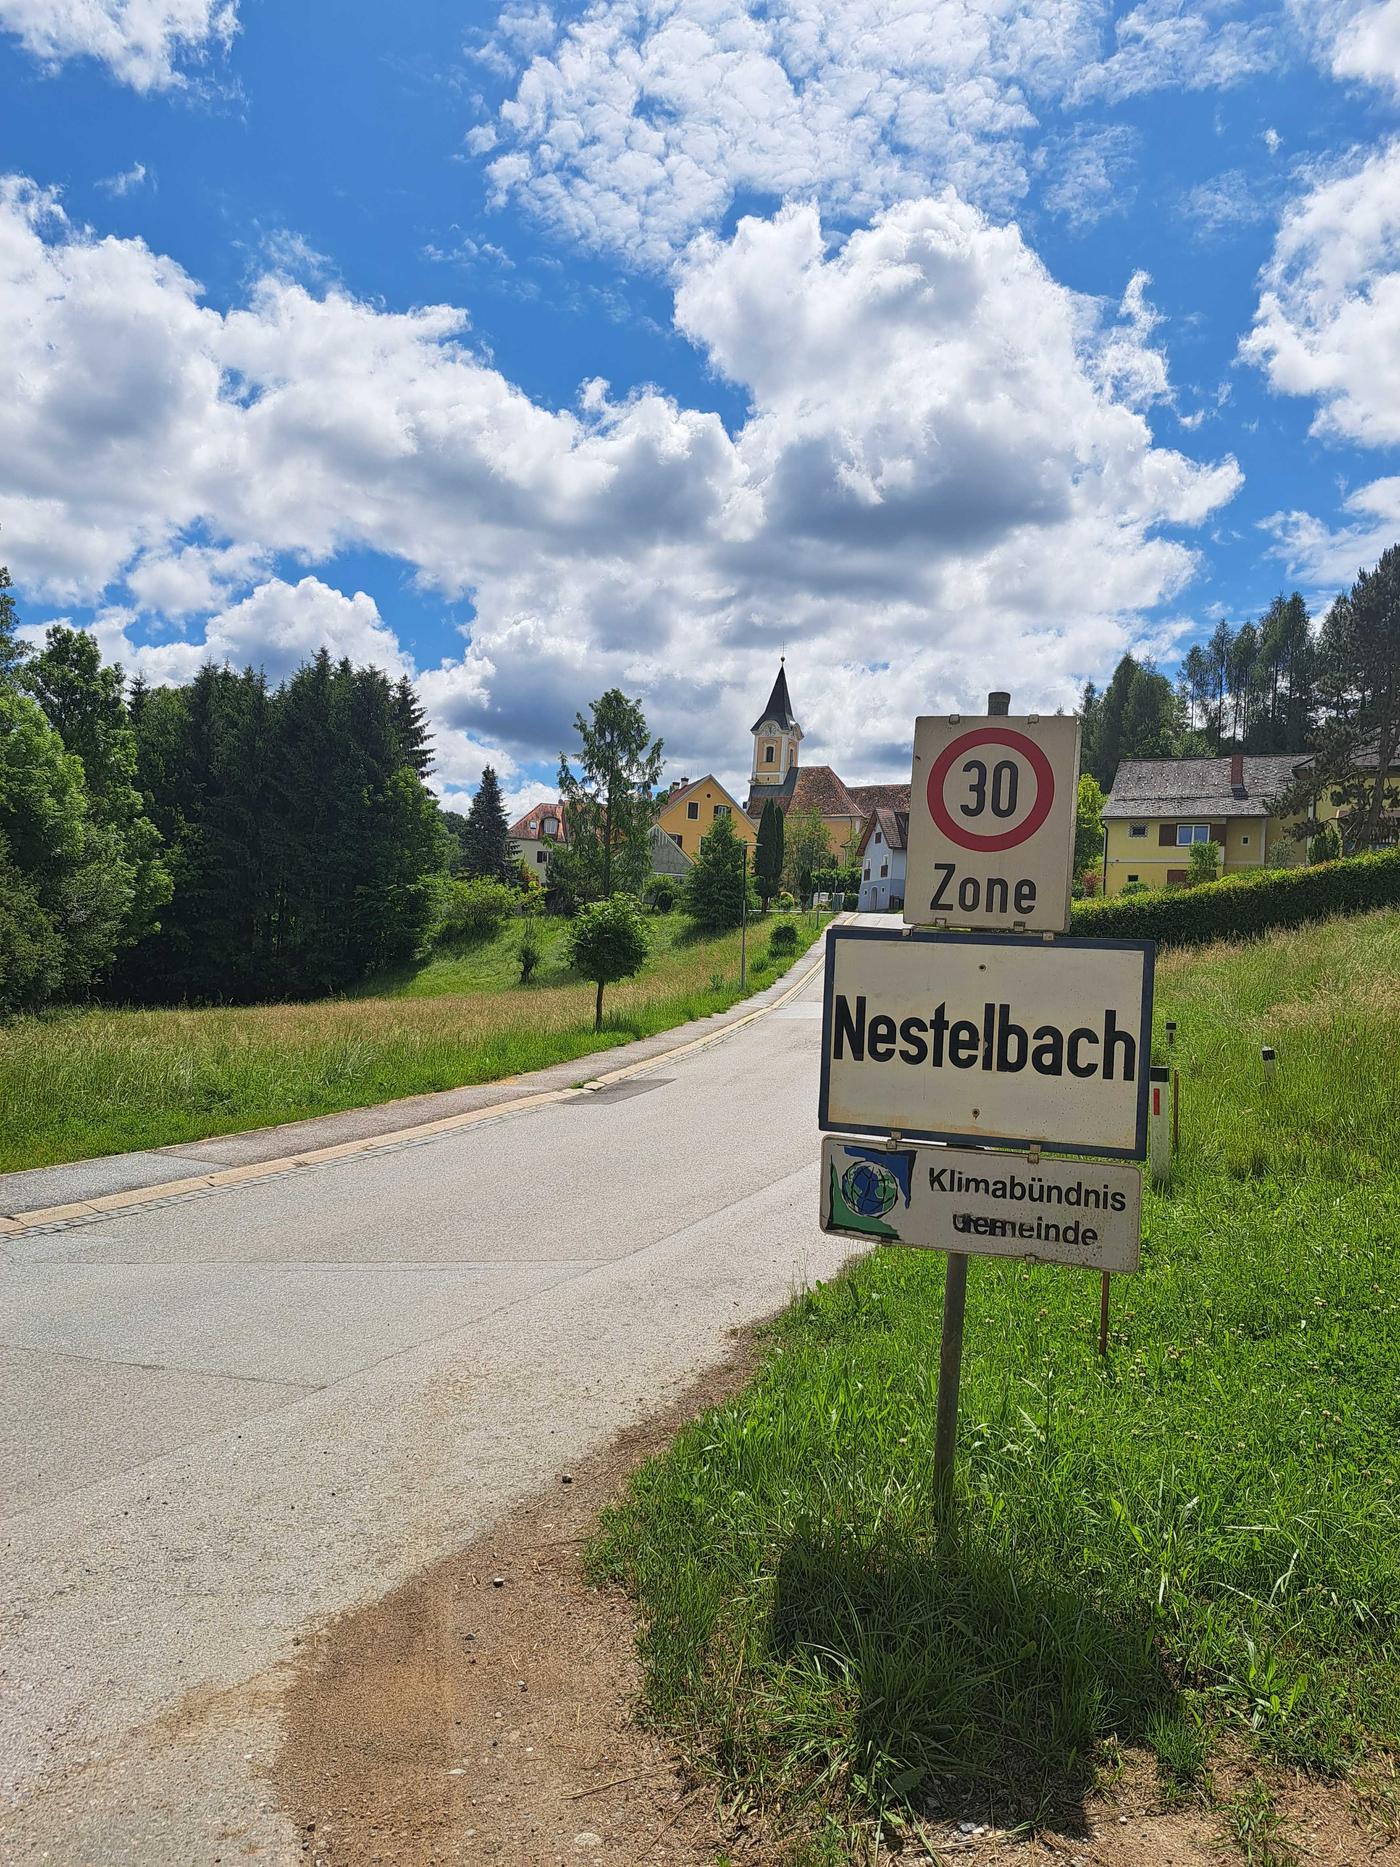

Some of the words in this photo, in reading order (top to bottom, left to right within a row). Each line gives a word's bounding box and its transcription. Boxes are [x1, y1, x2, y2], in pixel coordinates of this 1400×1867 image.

[961, 758, 1019, 818] 30
[930, 863, 1037, 915] Zone
[833, 994, 1136, 1083] Nestelbach
[928, 1167, 1127, 1212] Klimabündnis
